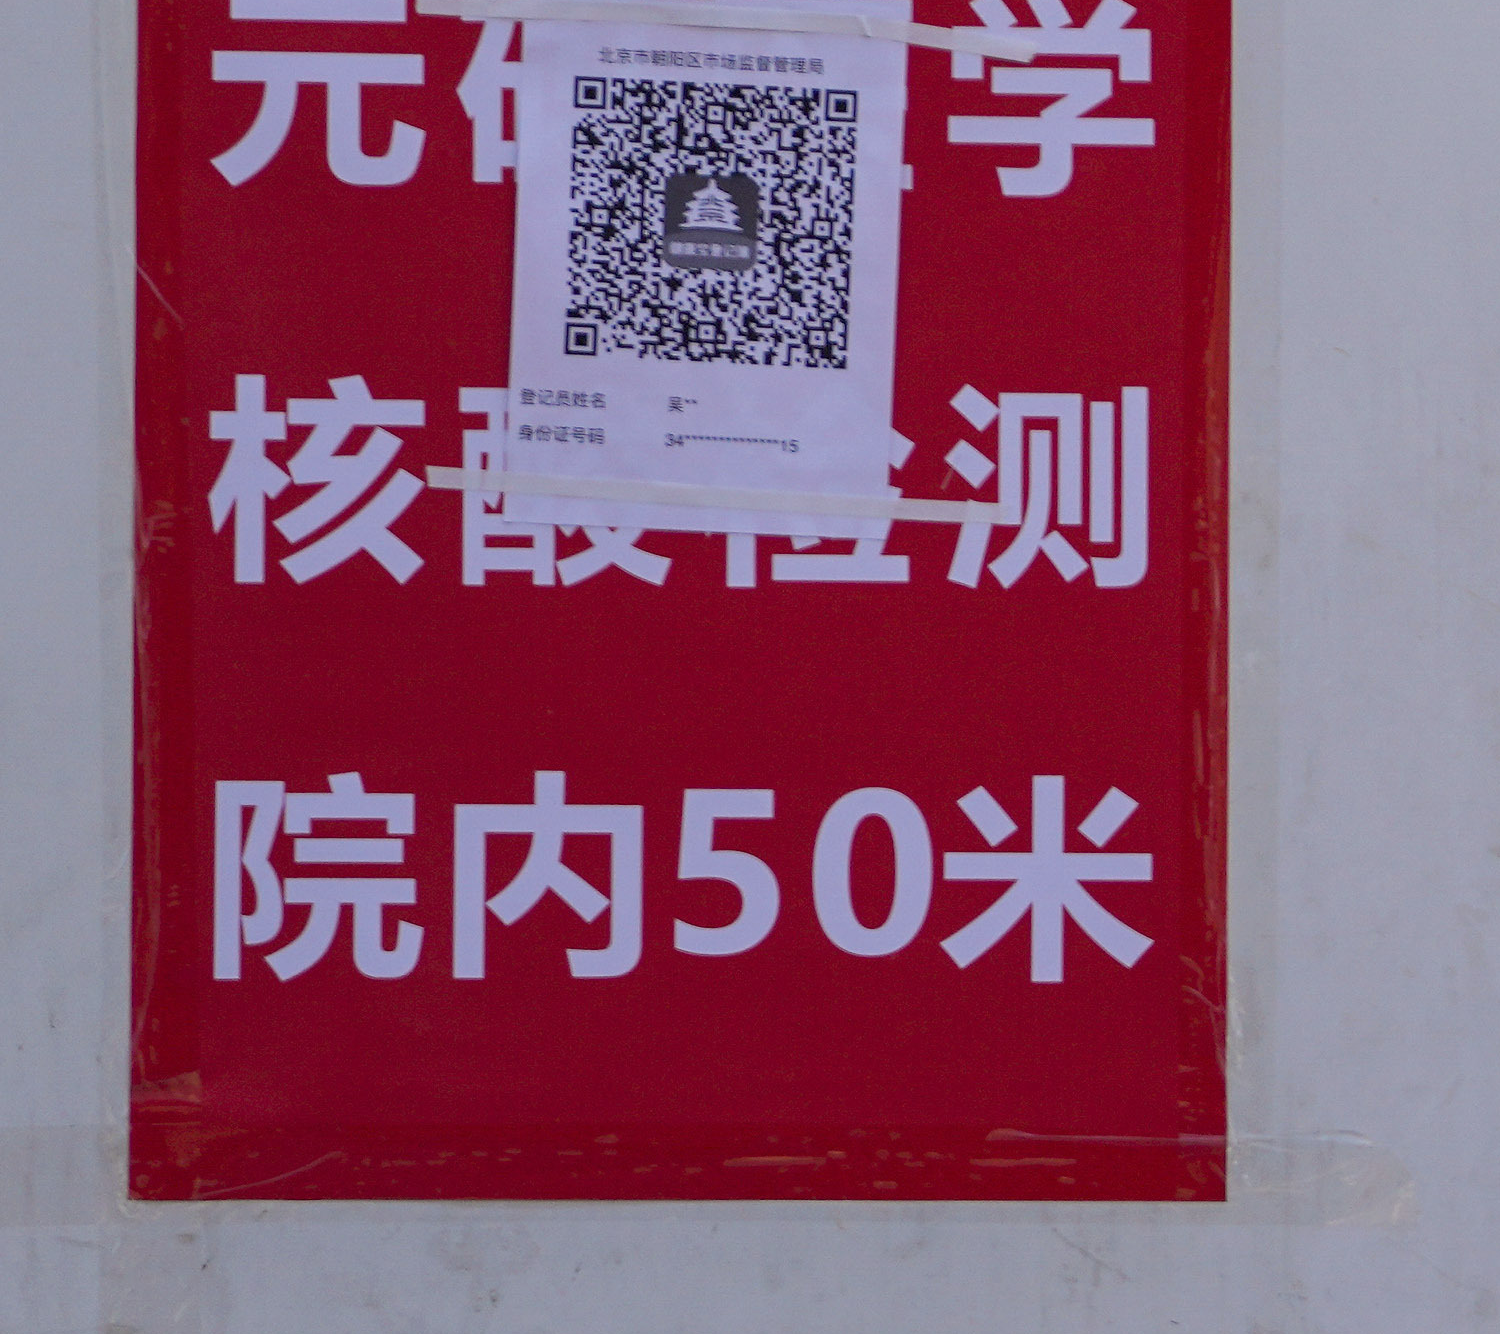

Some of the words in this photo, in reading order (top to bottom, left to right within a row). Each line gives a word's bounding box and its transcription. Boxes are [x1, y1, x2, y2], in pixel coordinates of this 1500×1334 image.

[598, 46, 825, 75] 北京市朝阳区市场监督管理局
[519, 387, 607, 409] 登记员姓名
[517, 424, 605, 445] 身份证号码
[212, 771, 1155, 984] 院内50米
